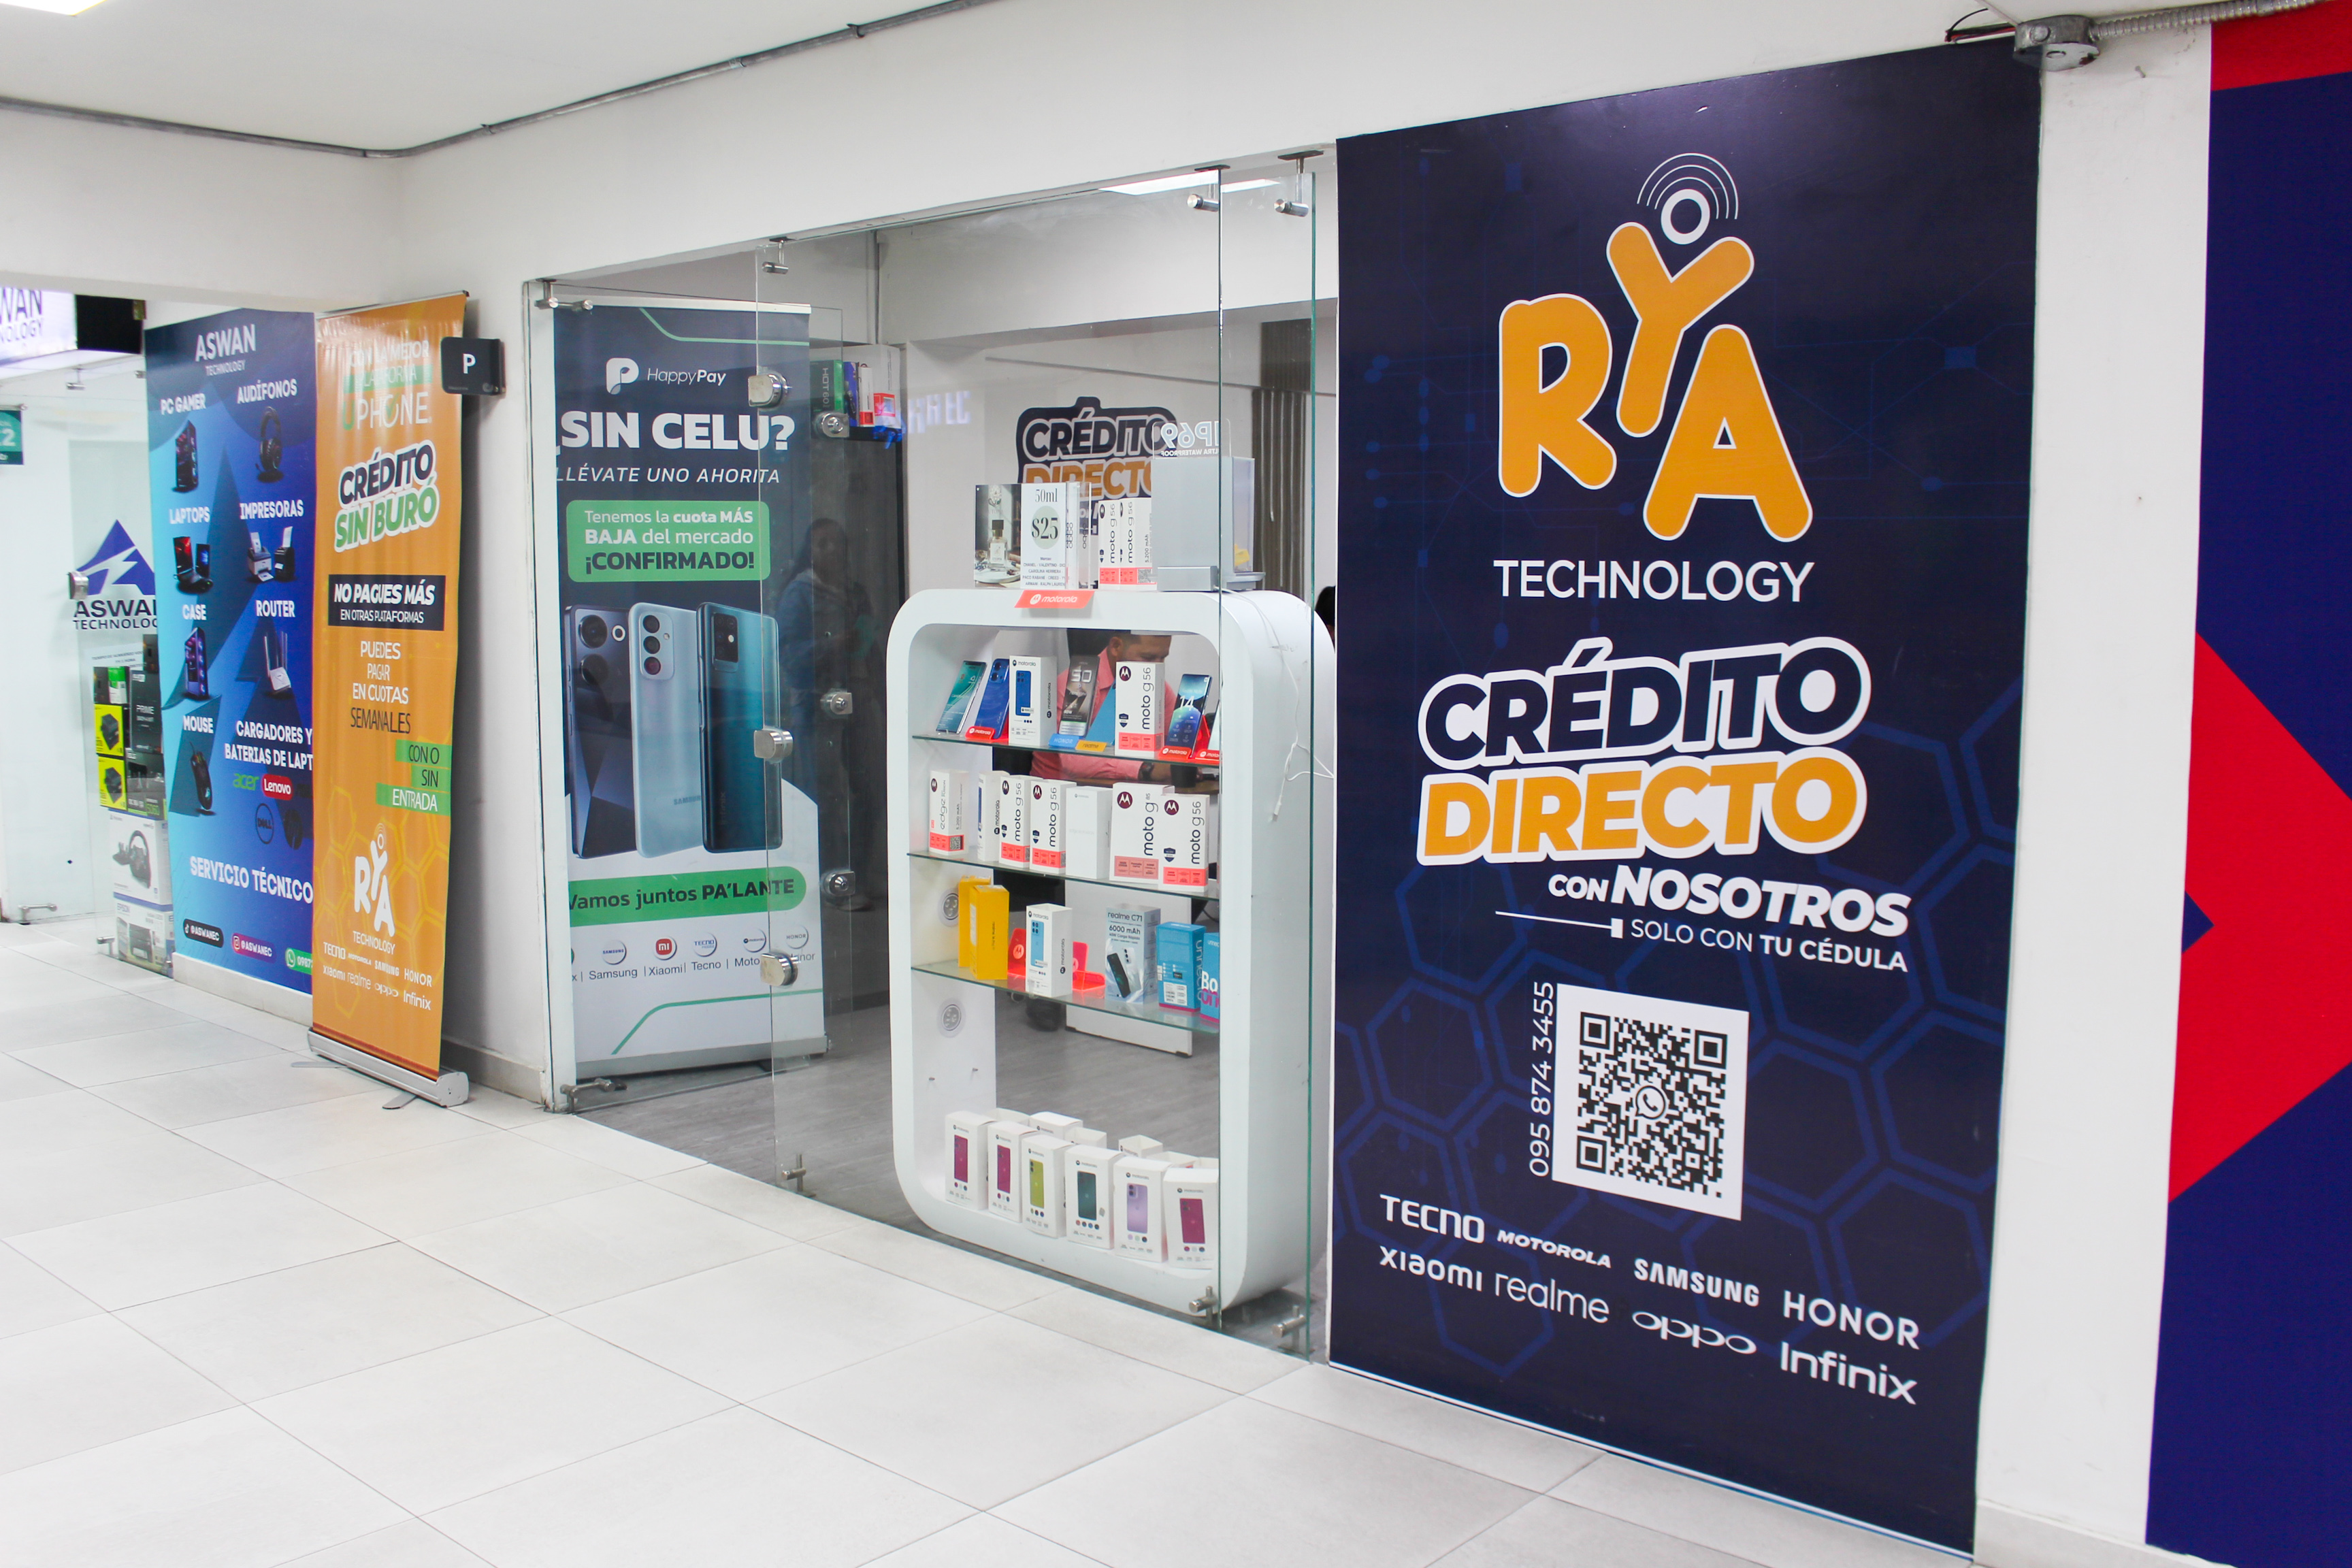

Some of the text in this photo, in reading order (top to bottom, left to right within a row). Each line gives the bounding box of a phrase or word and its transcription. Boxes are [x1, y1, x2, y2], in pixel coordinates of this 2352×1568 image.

[195, 324, 256, 361] ASWAN
[391, 340, 429, 361] MEJOR
[206, 360, 246, 377] TECHNOLOGY
[463, 353, 476, 374] P
[238, 379, 297, 404] AUDÍFONOS
[1499, 222, 1813, 542] RYA
[161, 393, 206, 415] PC GAMER
[652, 412, 795, 451] CELU?
[1024, 408, 1171, 460] CRÉDITO
[341, 444, 434, 505] CRÉDITO
[647, 468, 689, 483] UNO
[696, 468, 780, 484] AHORITA
[1034, 487, 1058, 503] 50ml
[169, 506, 210, 525] LAPTOPS
[240, 500, 304, 520] IMPRESORAS
[585, 507, 753, 523] Tenemos la cuota MÁS
[336, 506, 369, 549] SIN
[585, 529, 753, 545] BAJA del mercado
[1032, 517, 1058, 540] $25
[586, 551, 755, 574] ¡CONFIRMADO!
[334, 578, 436, 605] NO PAGUES MÁS
[1493, 559, 1815, 602] TECHNOLOGY
[182, 604, 207, 620] CASE
[256, 600, 295, 618] ROUTER
[340, 609, 424, 624] EN OTRAS PLATAFORMAS
[360, 640, 401, 660] PUEDES
[367, 663, 390, 681] PAGAR
[353, 683, 408, 704] EN CUOTAS
[1422, 638, 1867, 766] CRÉDITO
[183, 715, 214, 734] MOUSE
[350, 706, 410, 734] SEMANALES
[1141, 695, 1151, 730] moto
[236, 721, 313, 745] CARGADORES Y
[225, 744, 271, 765] BATERIAS
[273, 750, 287, 768] DE
[409, 745, 440, 764] CON O
[233, 773, 259, 791] acer
[264, 779, 291, 794] Lenovo
[421, 769, 440, 788] SIN
[393, 788, 438, 812] ENTRADA
[1420, 753, 1863, 861] DIRECTO
[258, 818, 272, 829] DELL
[1143, 817, 1154, 855] moto
[1190, 830, 1200, 864] moto
[190, 855, 313, 904] SERVICIO TÉCNICO
[635, 888, 697, 910] juntos
[1548, 864, 1912, 938] CON NOSOTROS
[191, 926, 272, 957] @ASWANEC @ASWANEC
[353, 930, 395, 955] TECHNOLOGY
[1631, 919, 1908, 973] SOLO CON TU CÉDULA
[323, 941, 432, 987] TECNO MOTOROLA SAMSUNG HONOR
[589, 968, 638, 979] Samsung
[649, 964, 683, 976] Xiaomi
[691, 960, 721, 970] Tecno
[735, 957, 760, 967] Moto
[347, 971, 371, 990] realme
[374, 982, 399, 997] oppo
[404, 990, 431, 1011] Infinix
[1529, 981, 1554, 1177] 095 874 3455
[1380, 1194, 1920, 1350] TECNO MOTOROLA SAMSUNG HONOR
[1496, 1272, 1609, 1324] realme
[1632, 1310, 1757, 1355] oppo
[1780, 1341, 1917, 1406] Infinix
